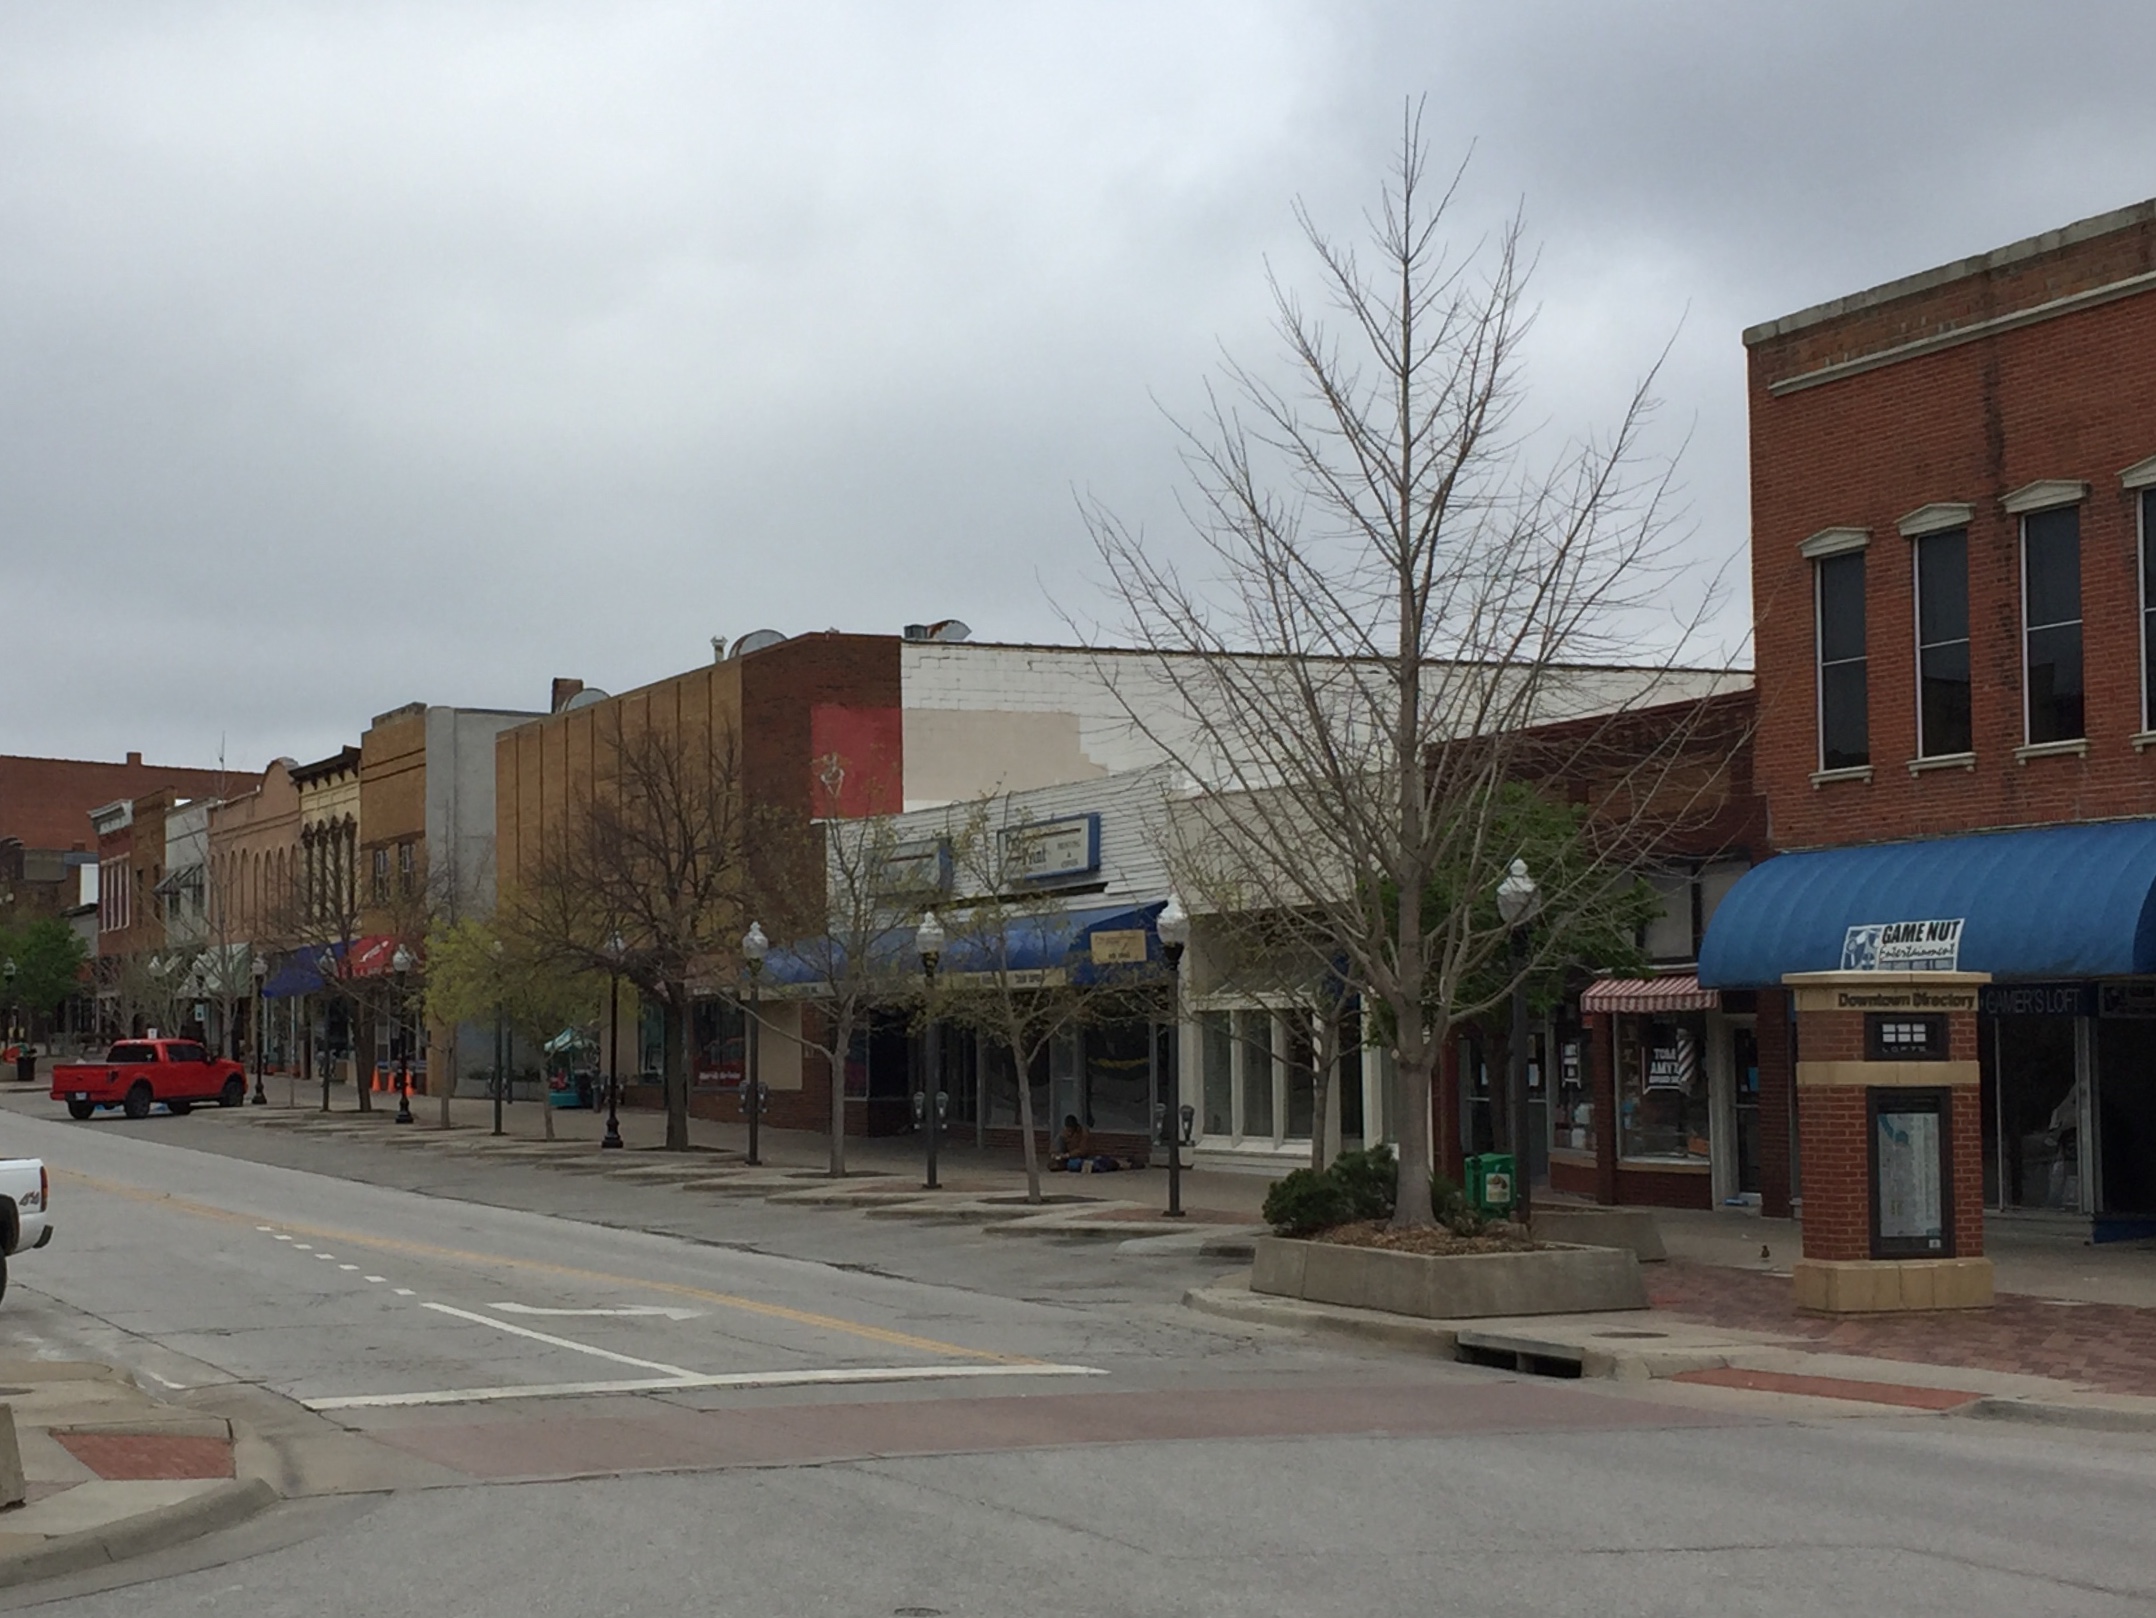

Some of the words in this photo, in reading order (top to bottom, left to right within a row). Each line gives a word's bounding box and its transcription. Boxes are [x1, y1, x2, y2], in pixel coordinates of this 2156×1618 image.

[1882, 923, 1927, 945] GAME
[1926, 920, 1961, 942] NUT
[1879, 943, 1956, 959] Entertainment
[1838, 992, 1911, 1008] Downtown
[1912, 991, 1975, 1010] Directory
[1985, 989, 2045, 1014] GAMER'S
[2046, 987, 2080, 1014] LOFT
